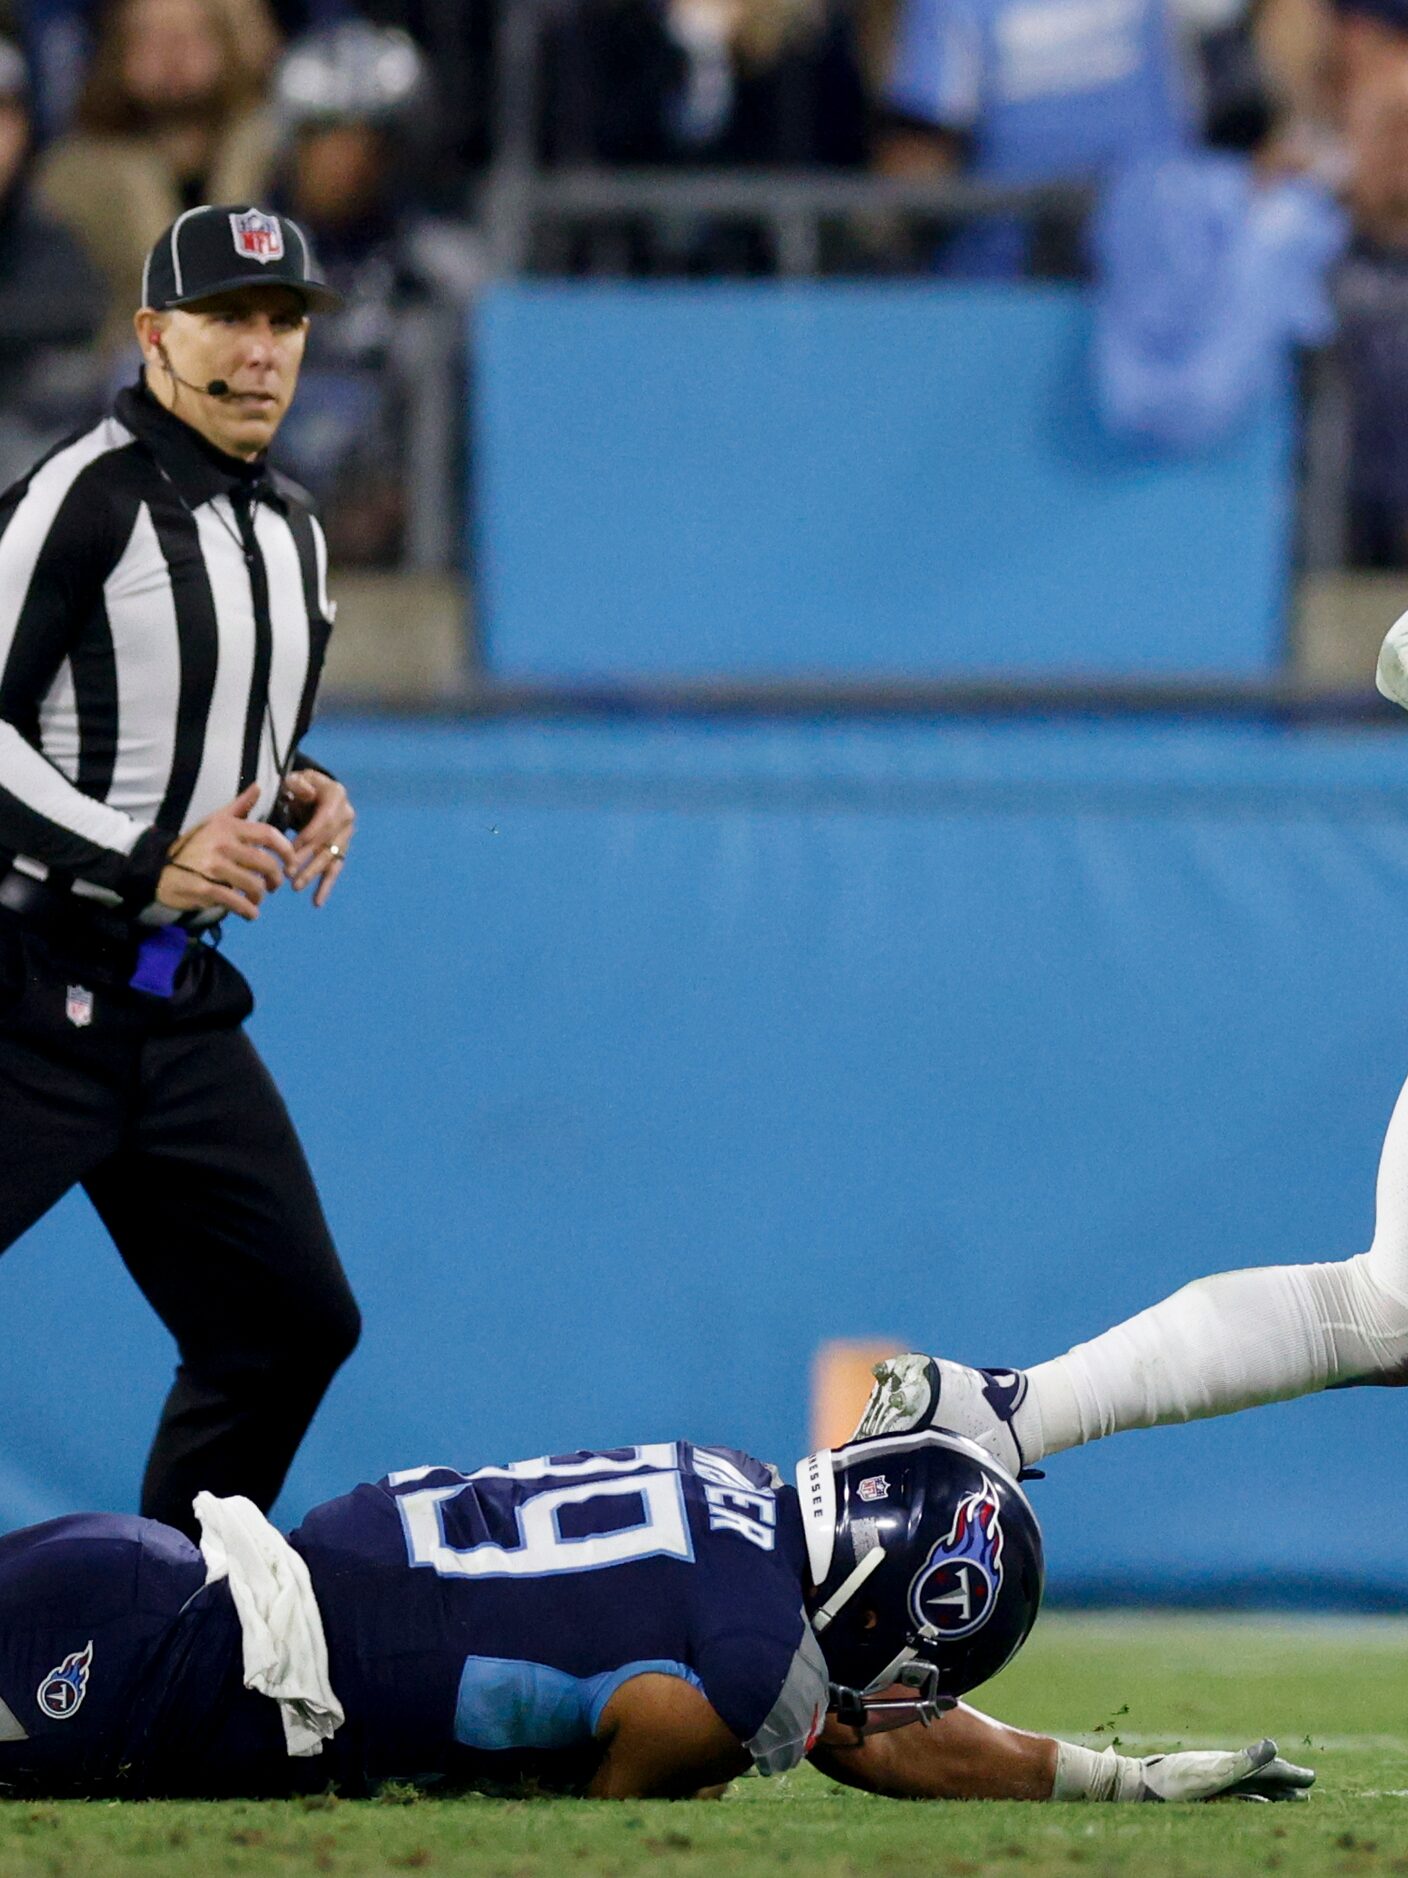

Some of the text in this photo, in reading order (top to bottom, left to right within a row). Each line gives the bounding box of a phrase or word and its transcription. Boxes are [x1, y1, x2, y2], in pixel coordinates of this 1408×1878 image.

[241, 230, 280, 254] NFL
[862, 1480, 876, 1499] NFL
[925, 1568, 971, 1620] T
[45, 1683, 67, 1709] T
